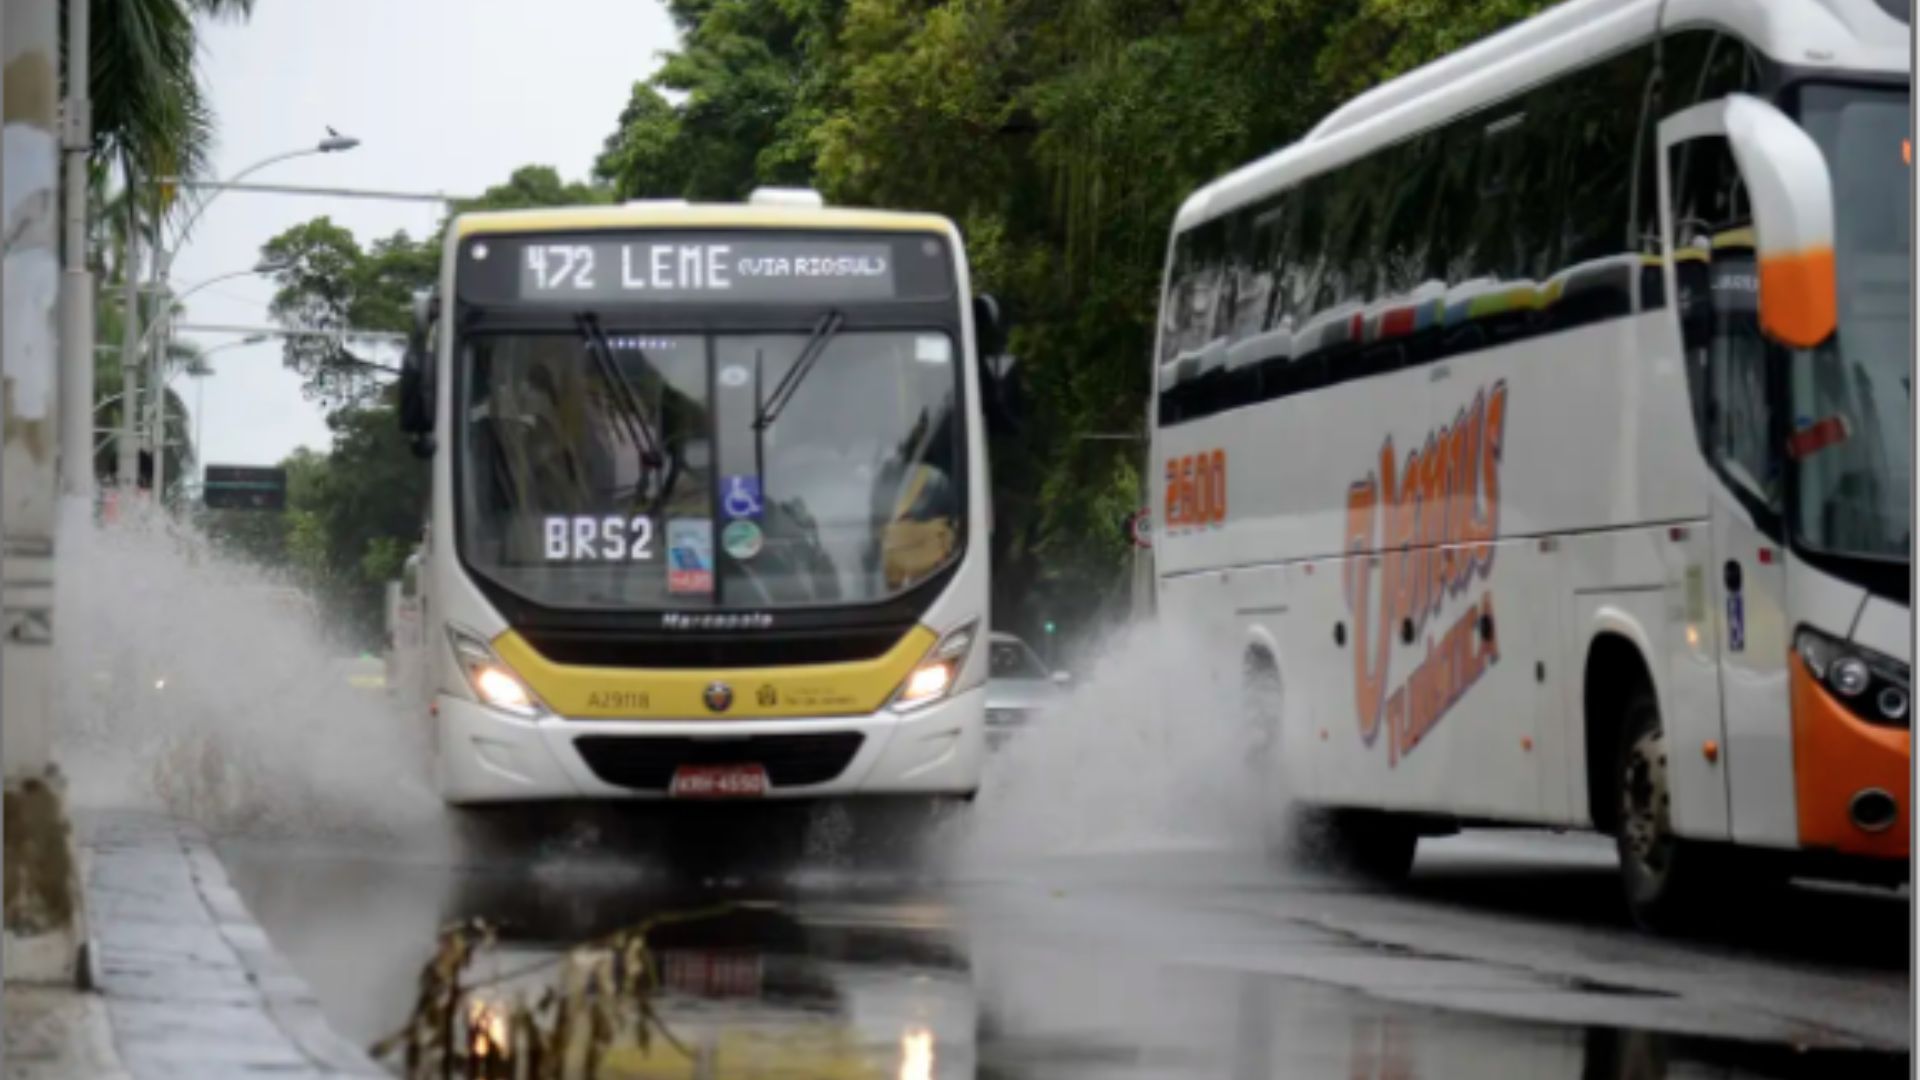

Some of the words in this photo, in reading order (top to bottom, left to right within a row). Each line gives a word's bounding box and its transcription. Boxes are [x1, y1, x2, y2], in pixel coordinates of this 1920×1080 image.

[528, 244, 595, 290] 472
[621, 244, 731, 290] LEME
[738, 257, 790, 277] (VIA
[545, 516, 653, 560] BRS2
